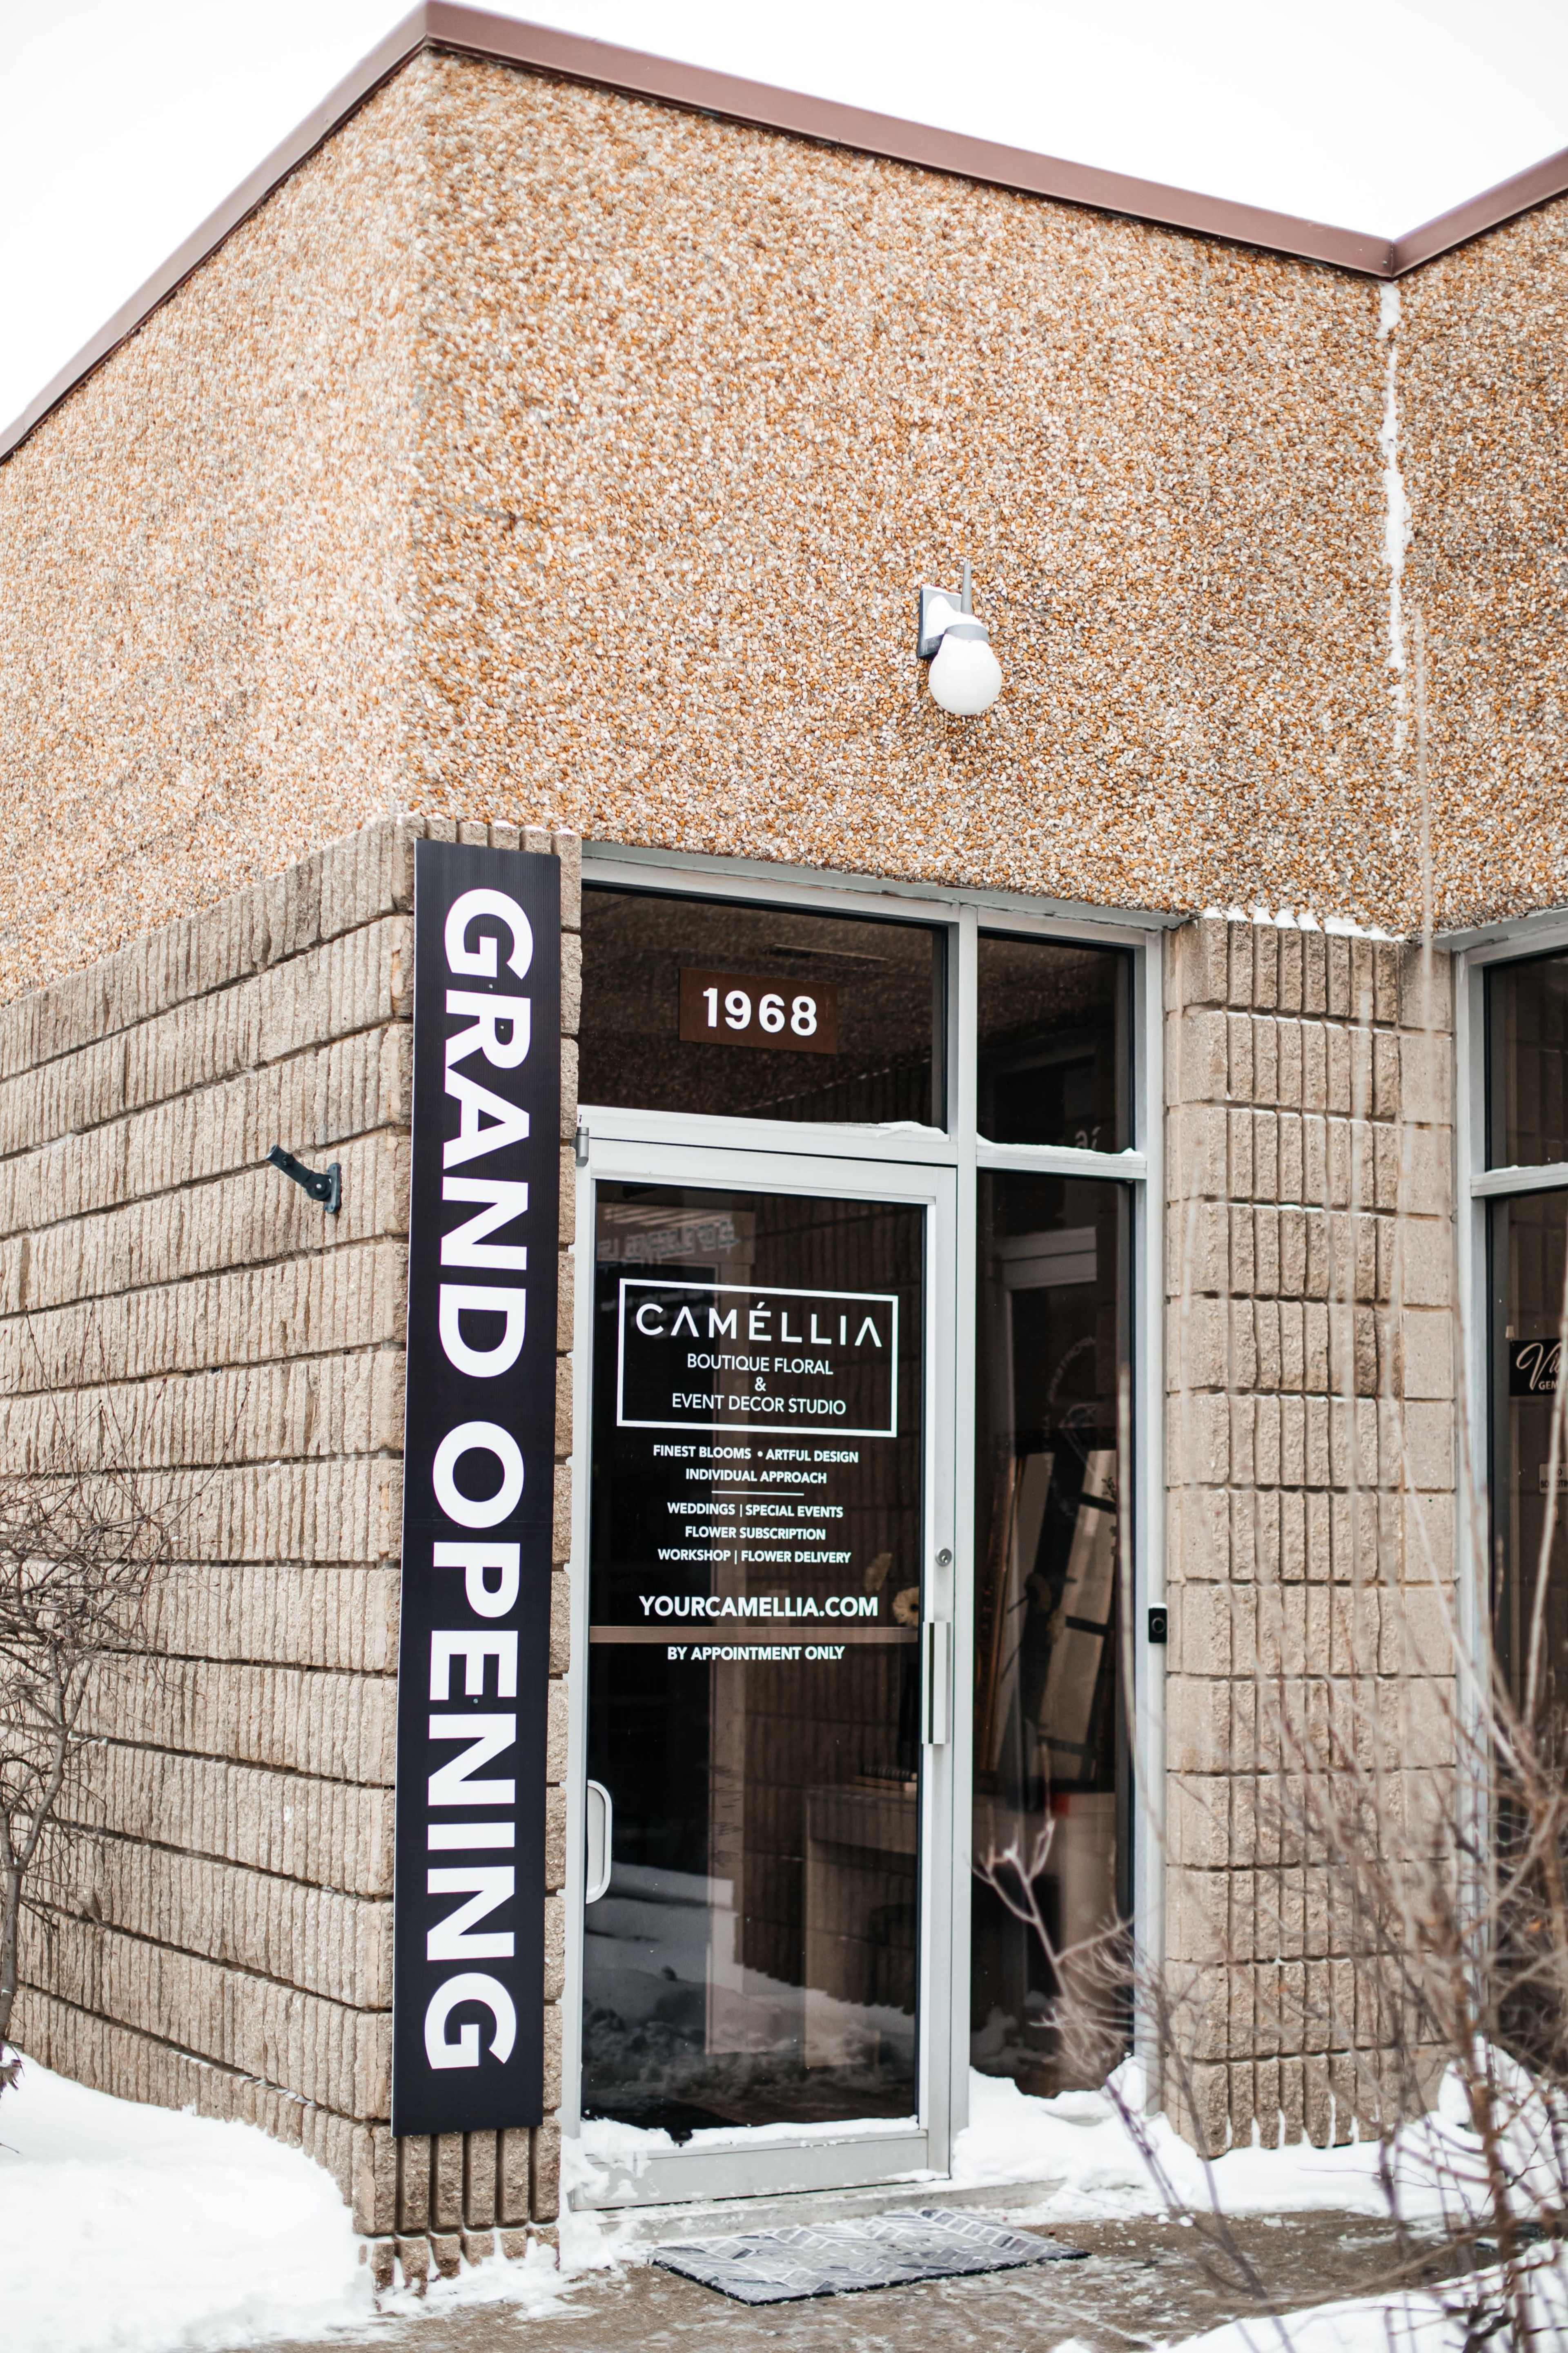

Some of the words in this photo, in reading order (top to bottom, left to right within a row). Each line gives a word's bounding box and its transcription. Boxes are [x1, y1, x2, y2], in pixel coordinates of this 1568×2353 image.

[703, 987, 817, 1036] 1968
[439, 889, 533, 1377] GRAND
[636, 1301, 882, 1347] CAMÉLLIA
[687, 1353, 770, 1372] BOUTIQUE
[774, 1357, 834, 1375] FLORAL
[754, 1376, 766, 1392] &
[672, 1392, 725, 1410] EVENT
[728, 1395, 784, 1412] DECOR
[788, 1398, 846, 1415] STUDIO
[653, 1444, 697, 1457] FINEST
[699, 1446, 752, 1460] BLOOMS
[765, 1448, 812, 1462] ARTFUL
[813, 1450, 859, 1463] DESIGN
[686, 1468, 758, 1482] INDIVIDUAL
[759, 1470, 827, 1484] APPROACH
[667, 1502, 736, 1516] WEDDINGS
[745, 1503, 795, 1517] SPECIAL
[797, 1505, 844, 1518] EVENTS
[685, 1526, 737, 1539] FLOWER
[739, 1526, 826, 1541] SUBSCRIPTION
[657, 1548, 732, 1562] WORKSHOP
[741, 1550, 792, 1563] FLOWER
[794, 1550, 852, 1563] DELIVERY
[639, 1595, 878, 1617] YOURCAMELLIA.COM
[667, 1646, 688, 1660] BY
[690, 1646, 802, 1661] APPOINTMENT
[804, 1646, 846, 1660] ONLY
[425, 1421, 524, 2069] OPENING
